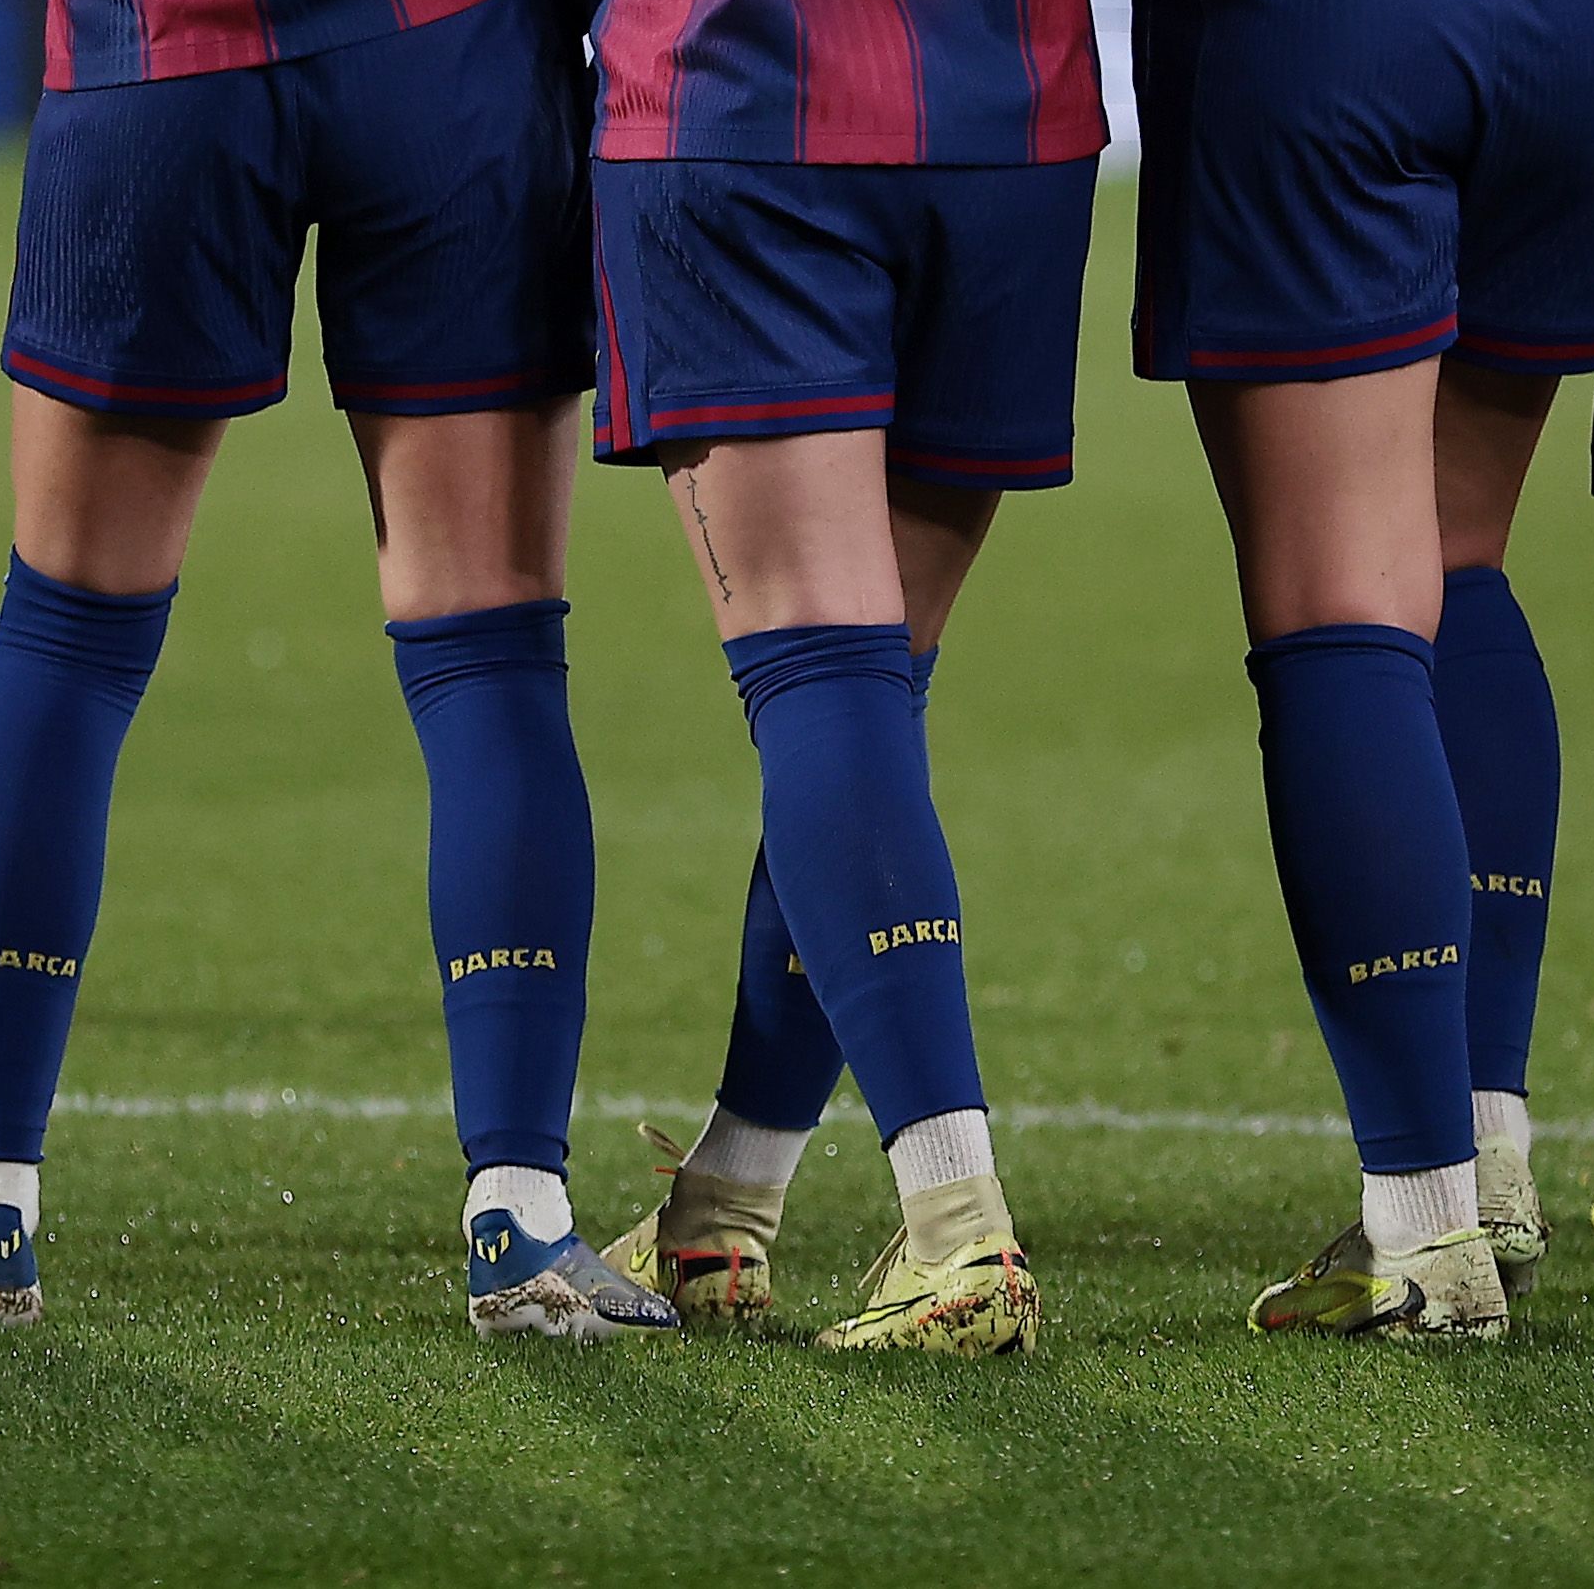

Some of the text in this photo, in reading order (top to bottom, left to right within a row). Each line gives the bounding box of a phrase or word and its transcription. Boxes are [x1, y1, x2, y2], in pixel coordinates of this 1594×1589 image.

[1470, 874, 1544, 899] ARÇA
[868, 919, 959, 956] BARÇA
[449, 948, 557, 983] BARÇA
[1349, 944, 1458, 985] BARÇA
